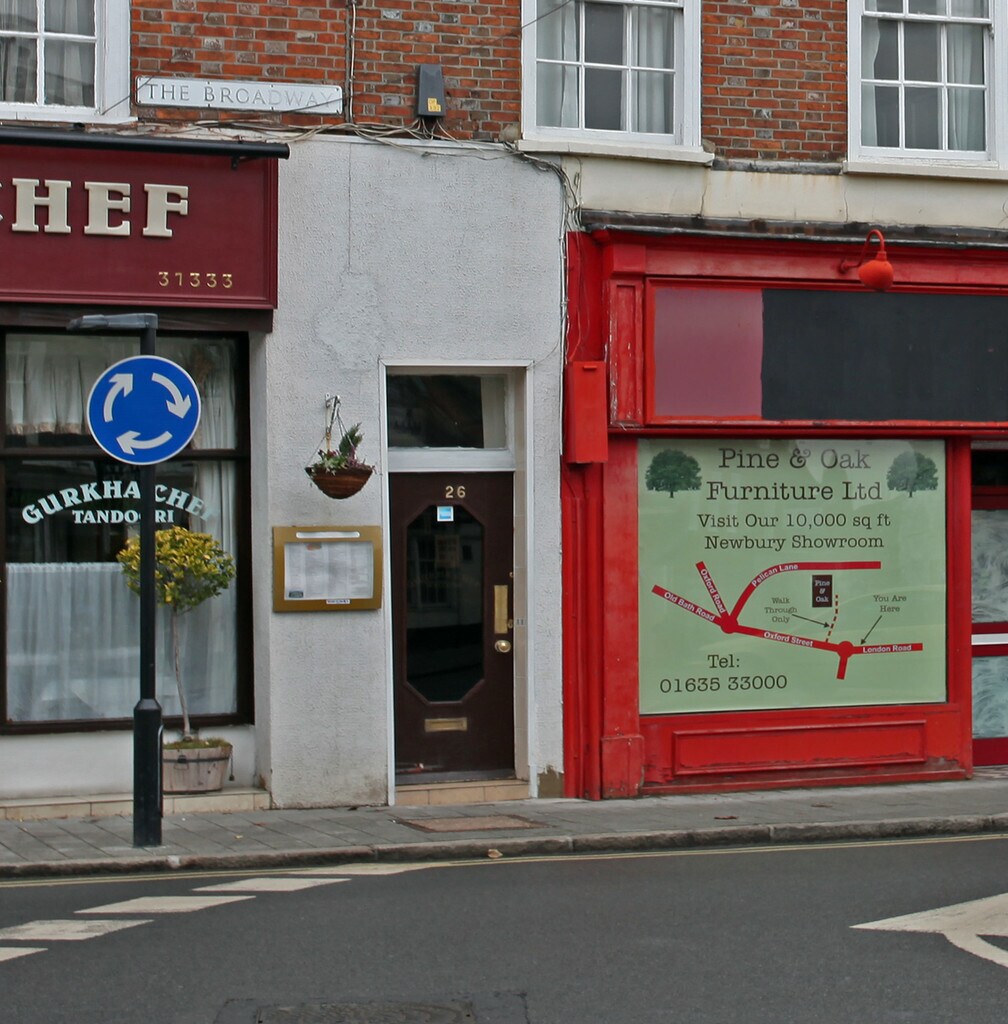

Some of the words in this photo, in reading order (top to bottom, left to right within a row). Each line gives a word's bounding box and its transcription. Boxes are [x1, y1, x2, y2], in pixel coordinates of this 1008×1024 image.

[147, 83, 190, 101] THE
[204, 86, 335, 108] BROADWAY
[0, 178, 189, 237] HEF
[718, 448, 779, 468] Pine
[789, 448, 811, 469] &
[820, 449, 871, 469] Oak
[445, 485, 466, 498] 26
[706, 481, 833, 500] Furniture
[842, 481, 882, 500] Ltd
[22, 480, 141, 524] GURKHA
[72, 509, 174, 524] TANDORI
[697, 514, 739, 527] Visit
[745, 514, 779, 527] Our
[786, 514, 846, 529] 10,000
[852, 516, 872, 529] sq
[877, 514, 891, 526] ft
[704, 536, 786, 552] Newbury
[792, 535, 884, 549] Showroom
[751, 567, 778, 587] Pelican
[779, 563, 799, 571] Lane
[814, 579, 831, 587] Pine
[700, 568, 716, 595] Oxford
[712, 593, 726, 614] Road
[664, 591, 677, 603] Old
[678, 598, 695, 612] Bath
[695, 607, 715, 622] Road
[771, 616, 790, 624] Only
[763, 631, 790, 642] Oxford
[791, 636, 813, 647] Street
[892, 644, 912, 652] Road
[707, 654, 740, 668] Tel:
[659, 678, 720, 693] 01635
[728, 675, 787, 690] 33000
